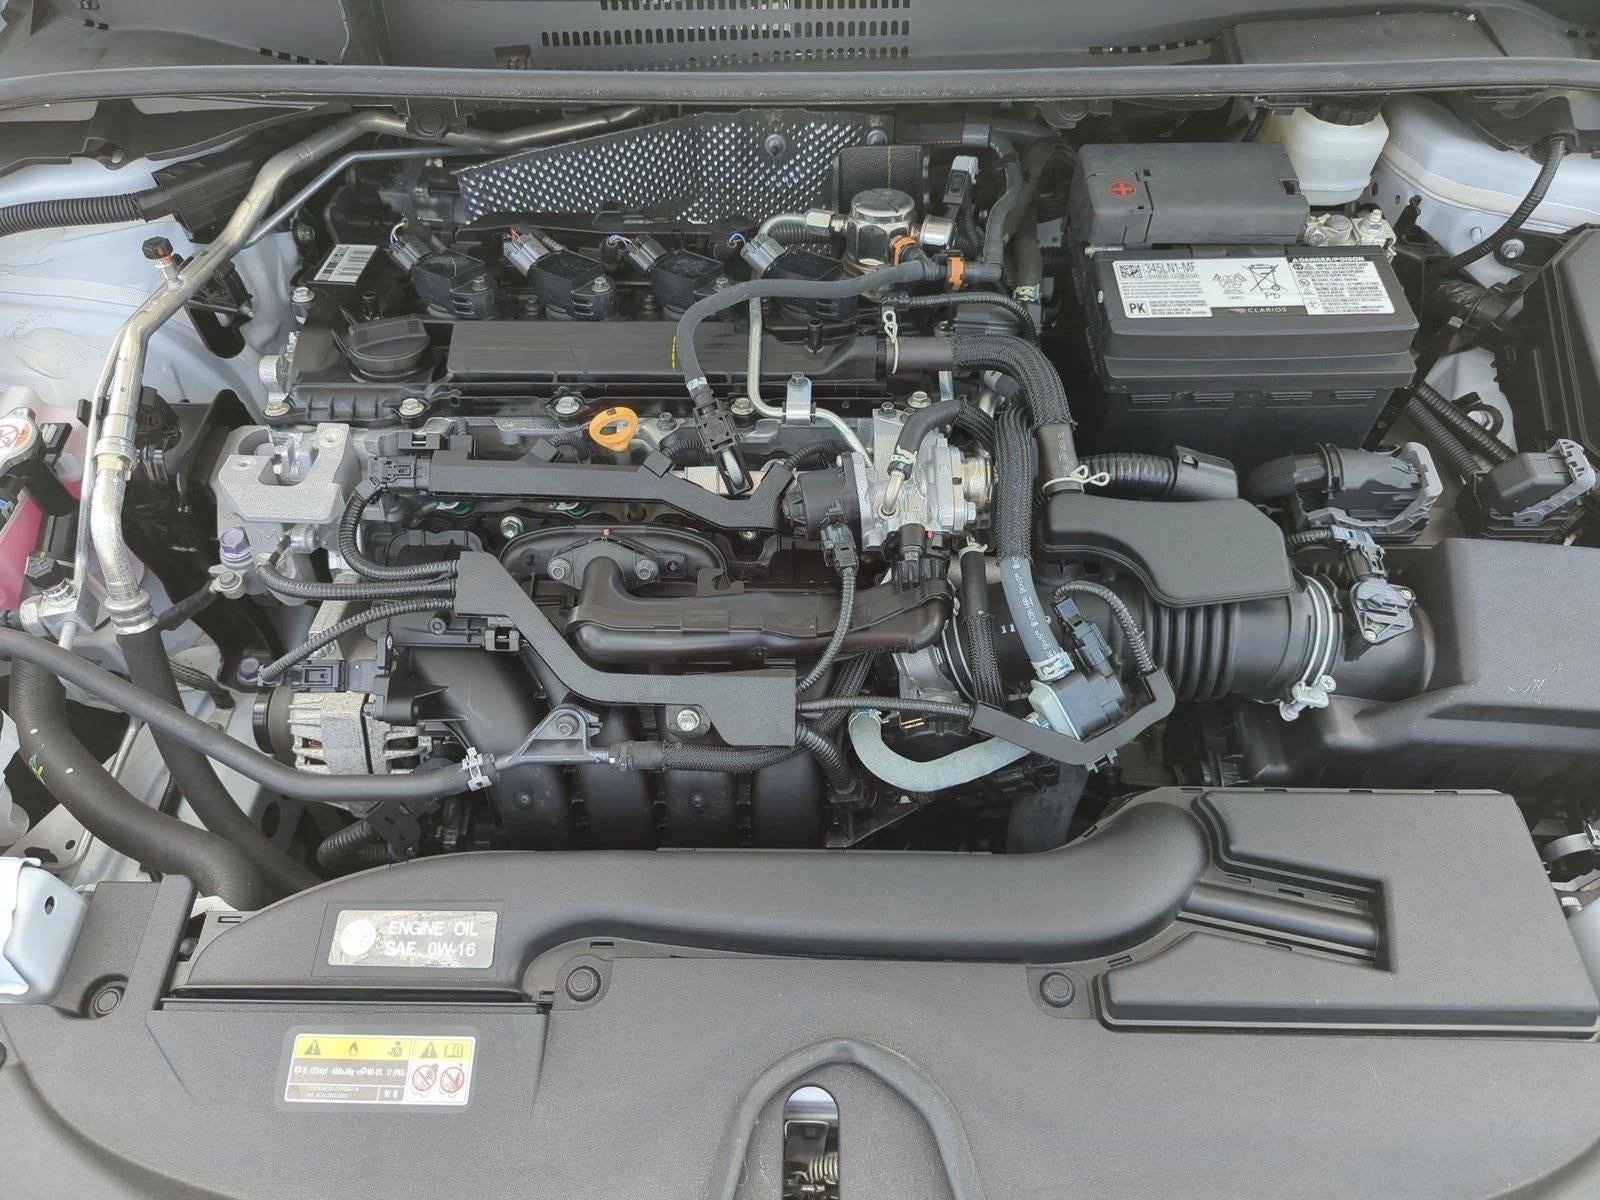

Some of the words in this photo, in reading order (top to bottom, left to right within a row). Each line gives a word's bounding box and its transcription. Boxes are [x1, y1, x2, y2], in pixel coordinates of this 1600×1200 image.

[1144, 261, 1196, 274] 345LN1-MF
[1264, 291, 1281, 299] Pb
[1128, 302, 1146, 314] PK
[388, 920, 445, 937] ENGINE
[454, 921, 479, 937] OIL
[384, 941, 417, 956] SAE
[427, 942, 476, 957] 0W-16
[384, 1089, 392, 1098] W
